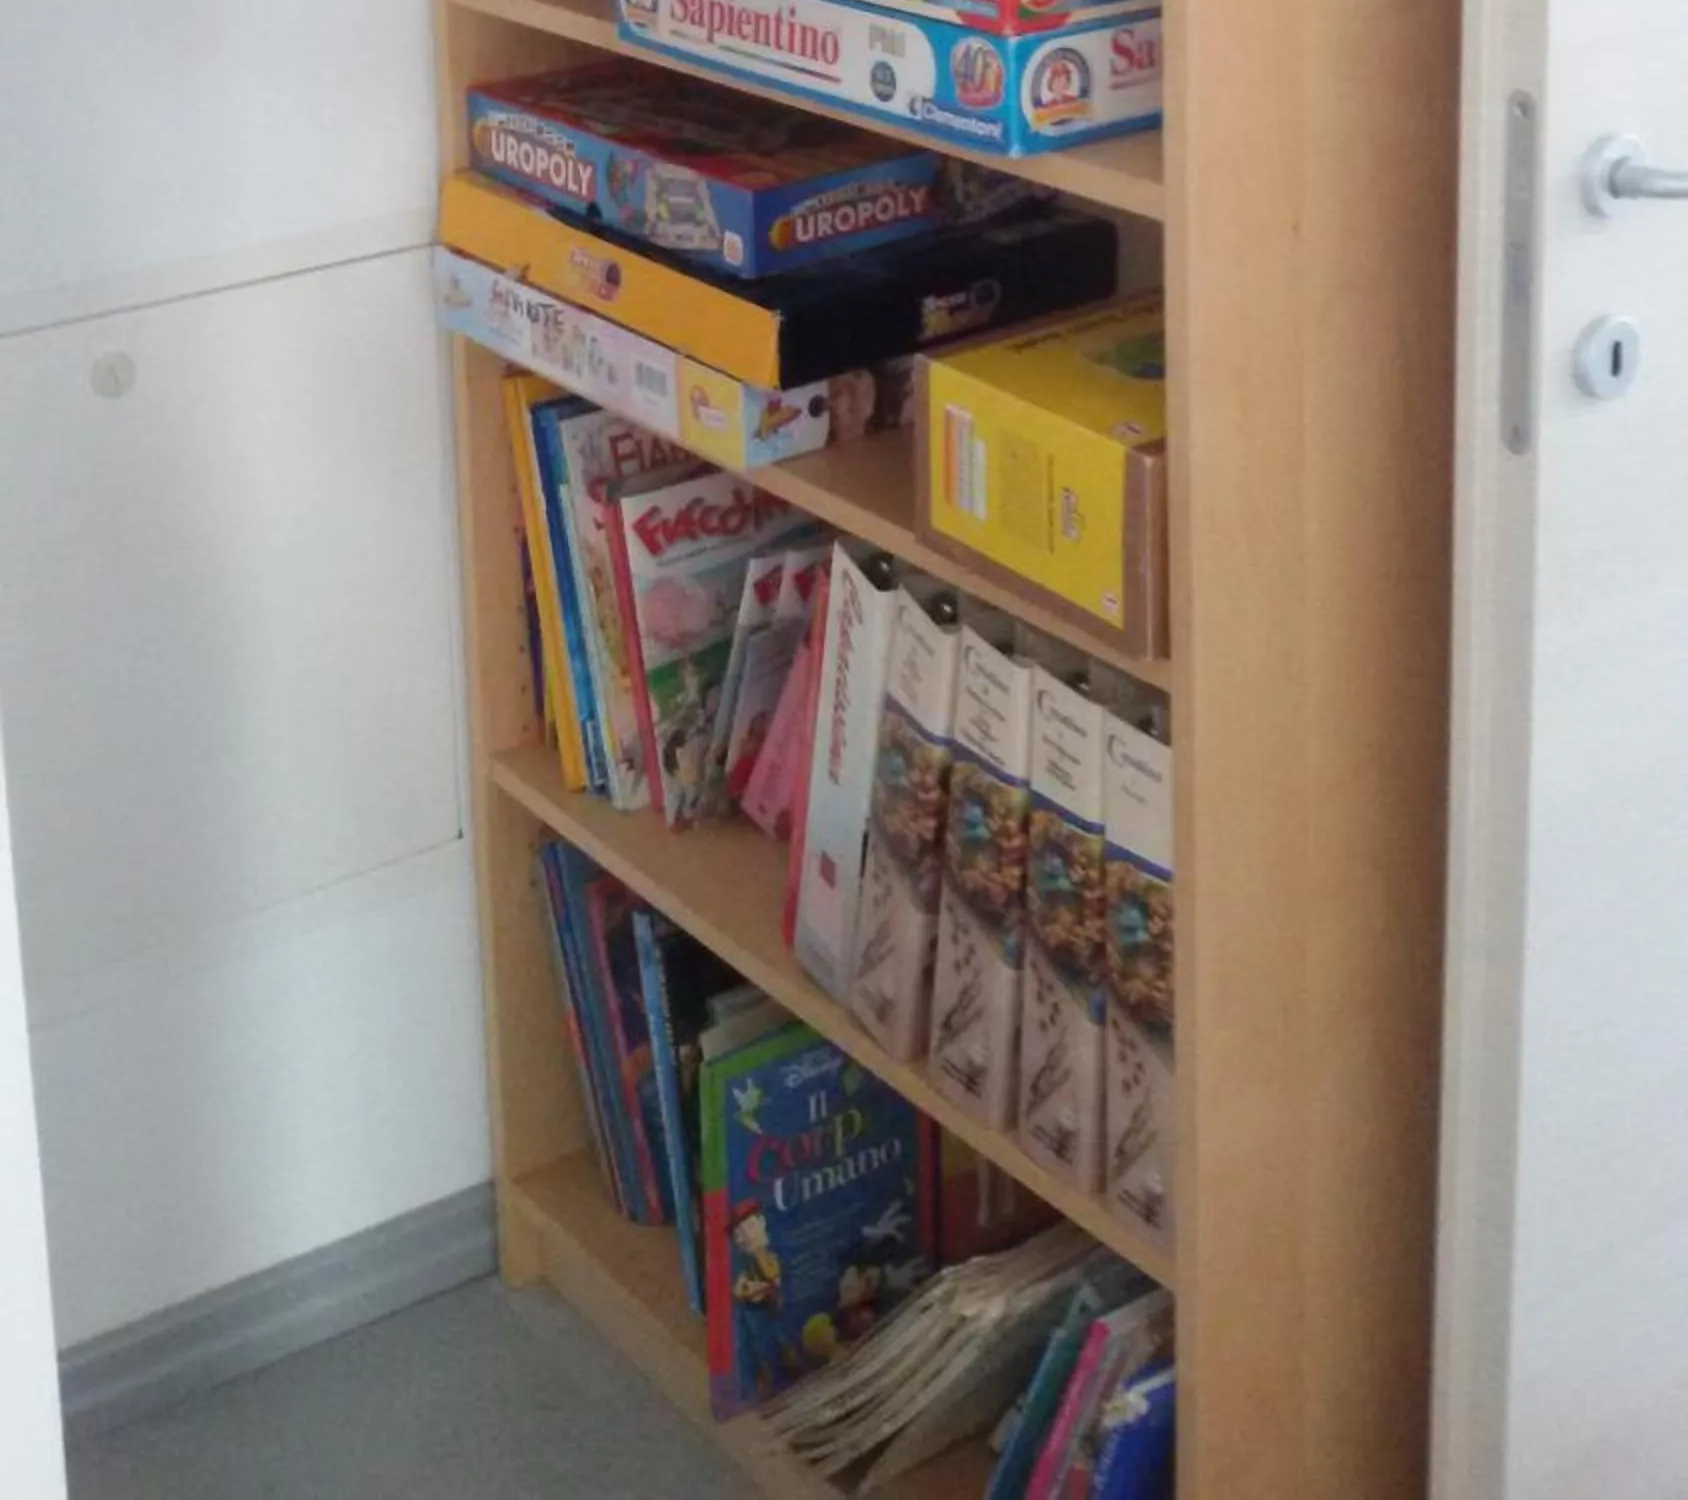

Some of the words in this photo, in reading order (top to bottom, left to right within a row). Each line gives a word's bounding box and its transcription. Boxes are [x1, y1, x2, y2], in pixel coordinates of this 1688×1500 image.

[1109, 28, 1158, 77] Sa
[809, 1090, 828, 1123] Il
[773, 1139, 901, 1212] Umano
